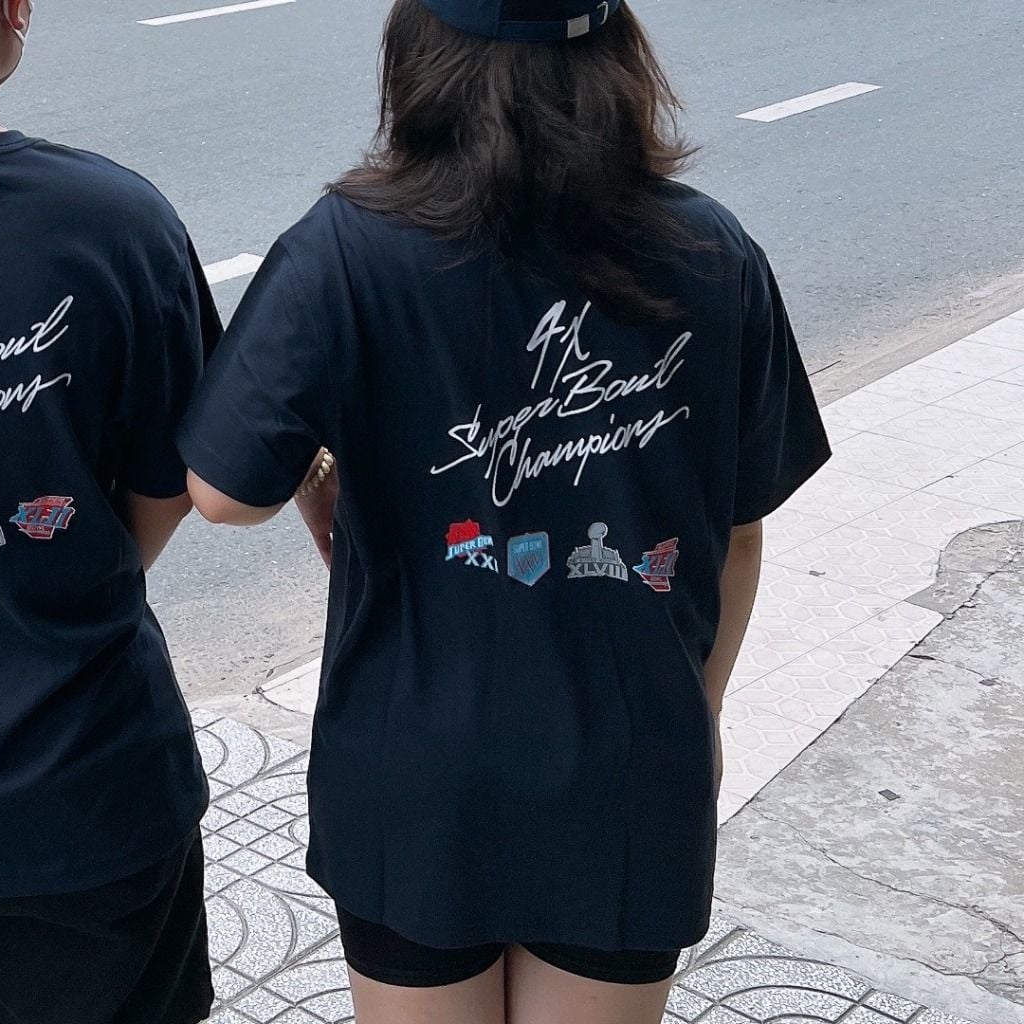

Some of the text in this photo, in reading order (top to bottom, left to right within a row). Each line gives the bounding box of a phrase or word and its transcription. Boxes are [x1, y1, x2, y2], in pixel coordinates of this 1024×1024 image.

[430, 331, 692, 479] Super Bowl
[491, 405, 689, 507] Champions
